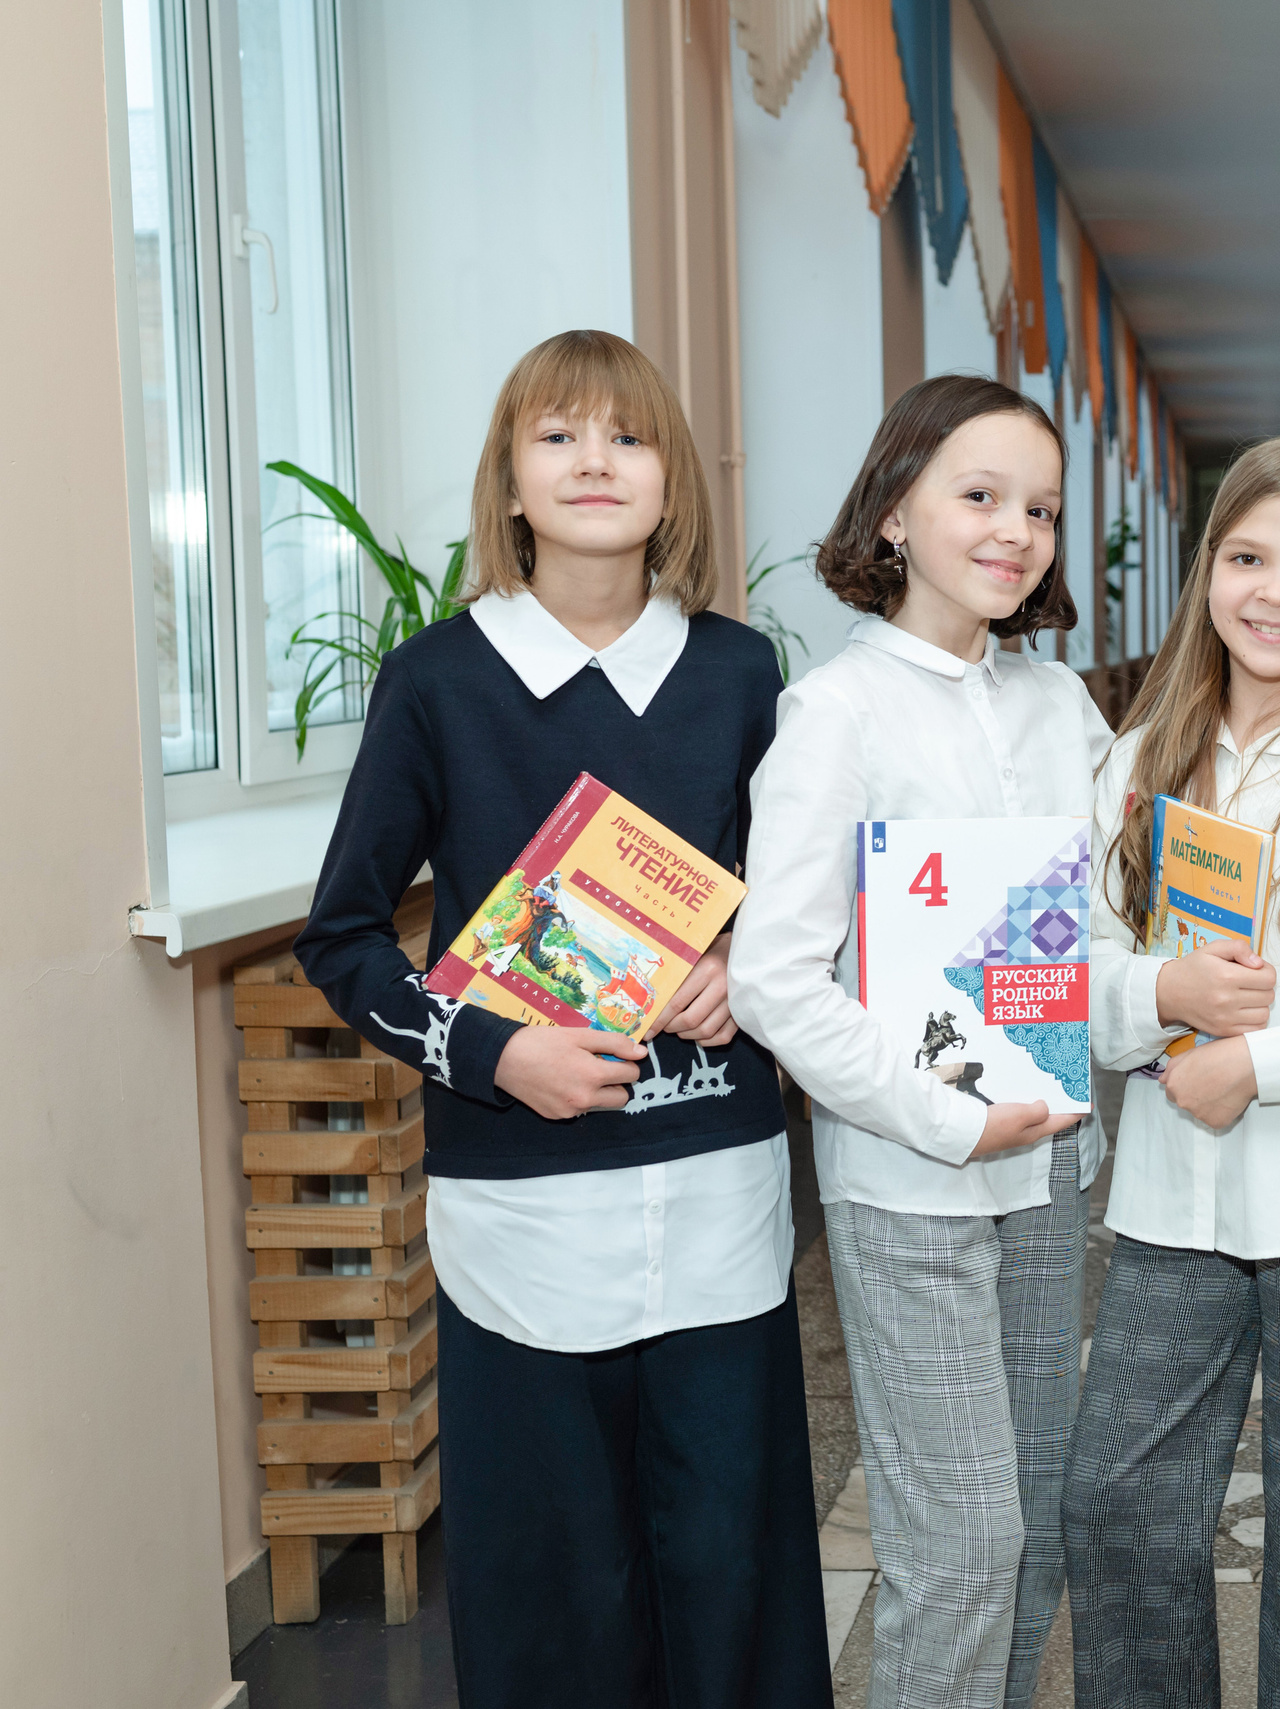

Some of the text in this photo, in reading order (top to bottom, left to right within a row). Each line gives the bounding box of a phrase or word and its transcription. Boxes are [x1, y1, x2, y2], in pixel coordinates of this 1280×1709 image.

[610, 816, 719, 894] ЛИТЕРАТУРНОЕ
[1170, 836, 1242, 883] МАТЕМАТИКА
[616, 836, 710, 914] ЧТЕНИЕ
[908, 852, 949, 907] 4
[1237, 895, 1241, 904] 1
[686, 920, 692, 929] 1
[484, 942, 561, 1011] 4 КЛАСС
[991, 964, 1078, 985] РУССКИЙ
[991, 983, 1069, 1005] РОДНОЙ
[992, 1004, 1045, 1021] ЯЗЫК
